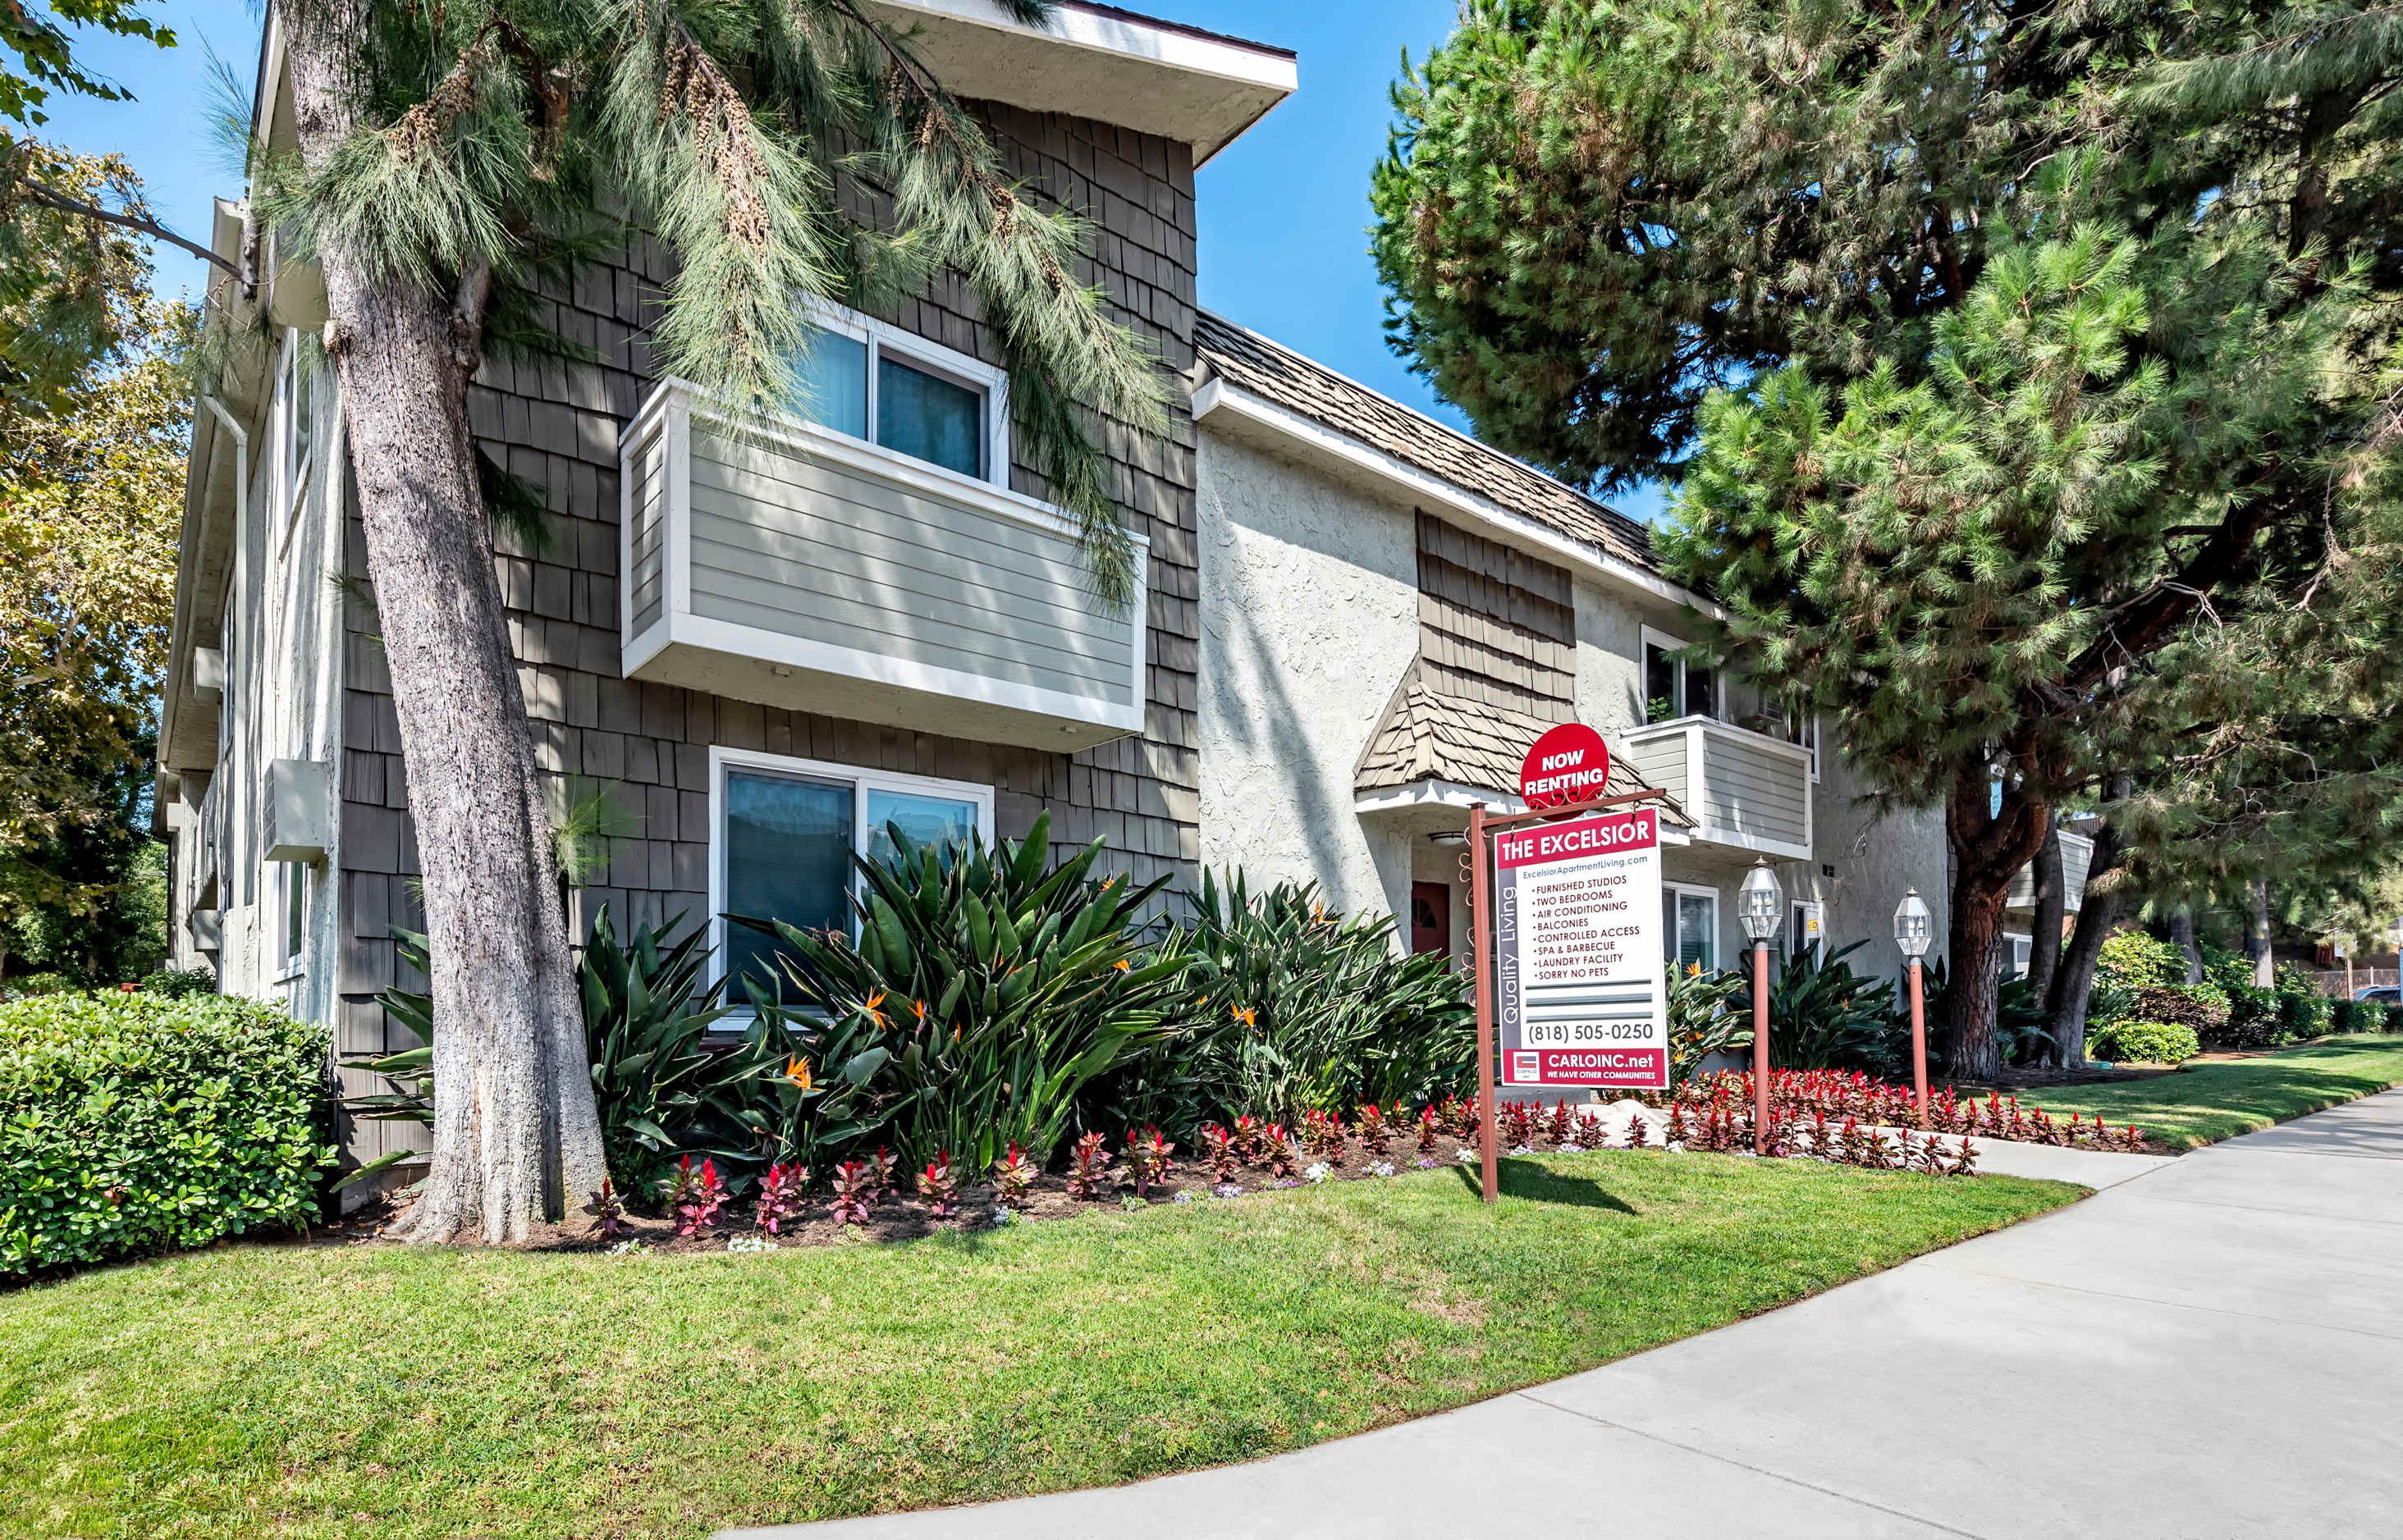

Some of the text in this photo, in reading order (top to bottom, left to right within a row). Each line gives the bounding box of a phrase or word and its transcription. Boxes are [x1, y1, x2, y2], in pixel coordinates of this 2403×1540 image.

[1542, 749, 1585, 771] NOW
[1525, 768, 1603, 796] RENTING
[1502, 820, 1650, 861] THE EXCELSIOR
[1523, 856, 1648, 879] ExcelsiorApartmentLiving.com
[1536, 875, 1627, 894] FURNISHED STUDIOS
[1536, 889, 1613, 907] TWO BEDROOMS
[1537, 901, 1627, 918] AIR CONDITIONING
[1537, 918, 1589, 930] BALCONIES
[1537, 925, 1640, 943] CONTROLLED ACCESS
[1500, 886, 1519, 1024] Quality Living
[1538, 946, 1555, 955] SPA
[1567, 941, 1615, 953] BARBECUE
[1539, 953, 1623, 968] LAUNDRY FACILITY
[1539, 967, 1609, 980] SORRY NO PETS
[1529, 1023, 1654, 1044] (818) 505-0250
[1548, 1053, 1654, 1068] CARLOINC.net
[1579, 1071, 1602, 1079] OTHER
[1603, 1072, 1655, 1080] COMMUNITIES
